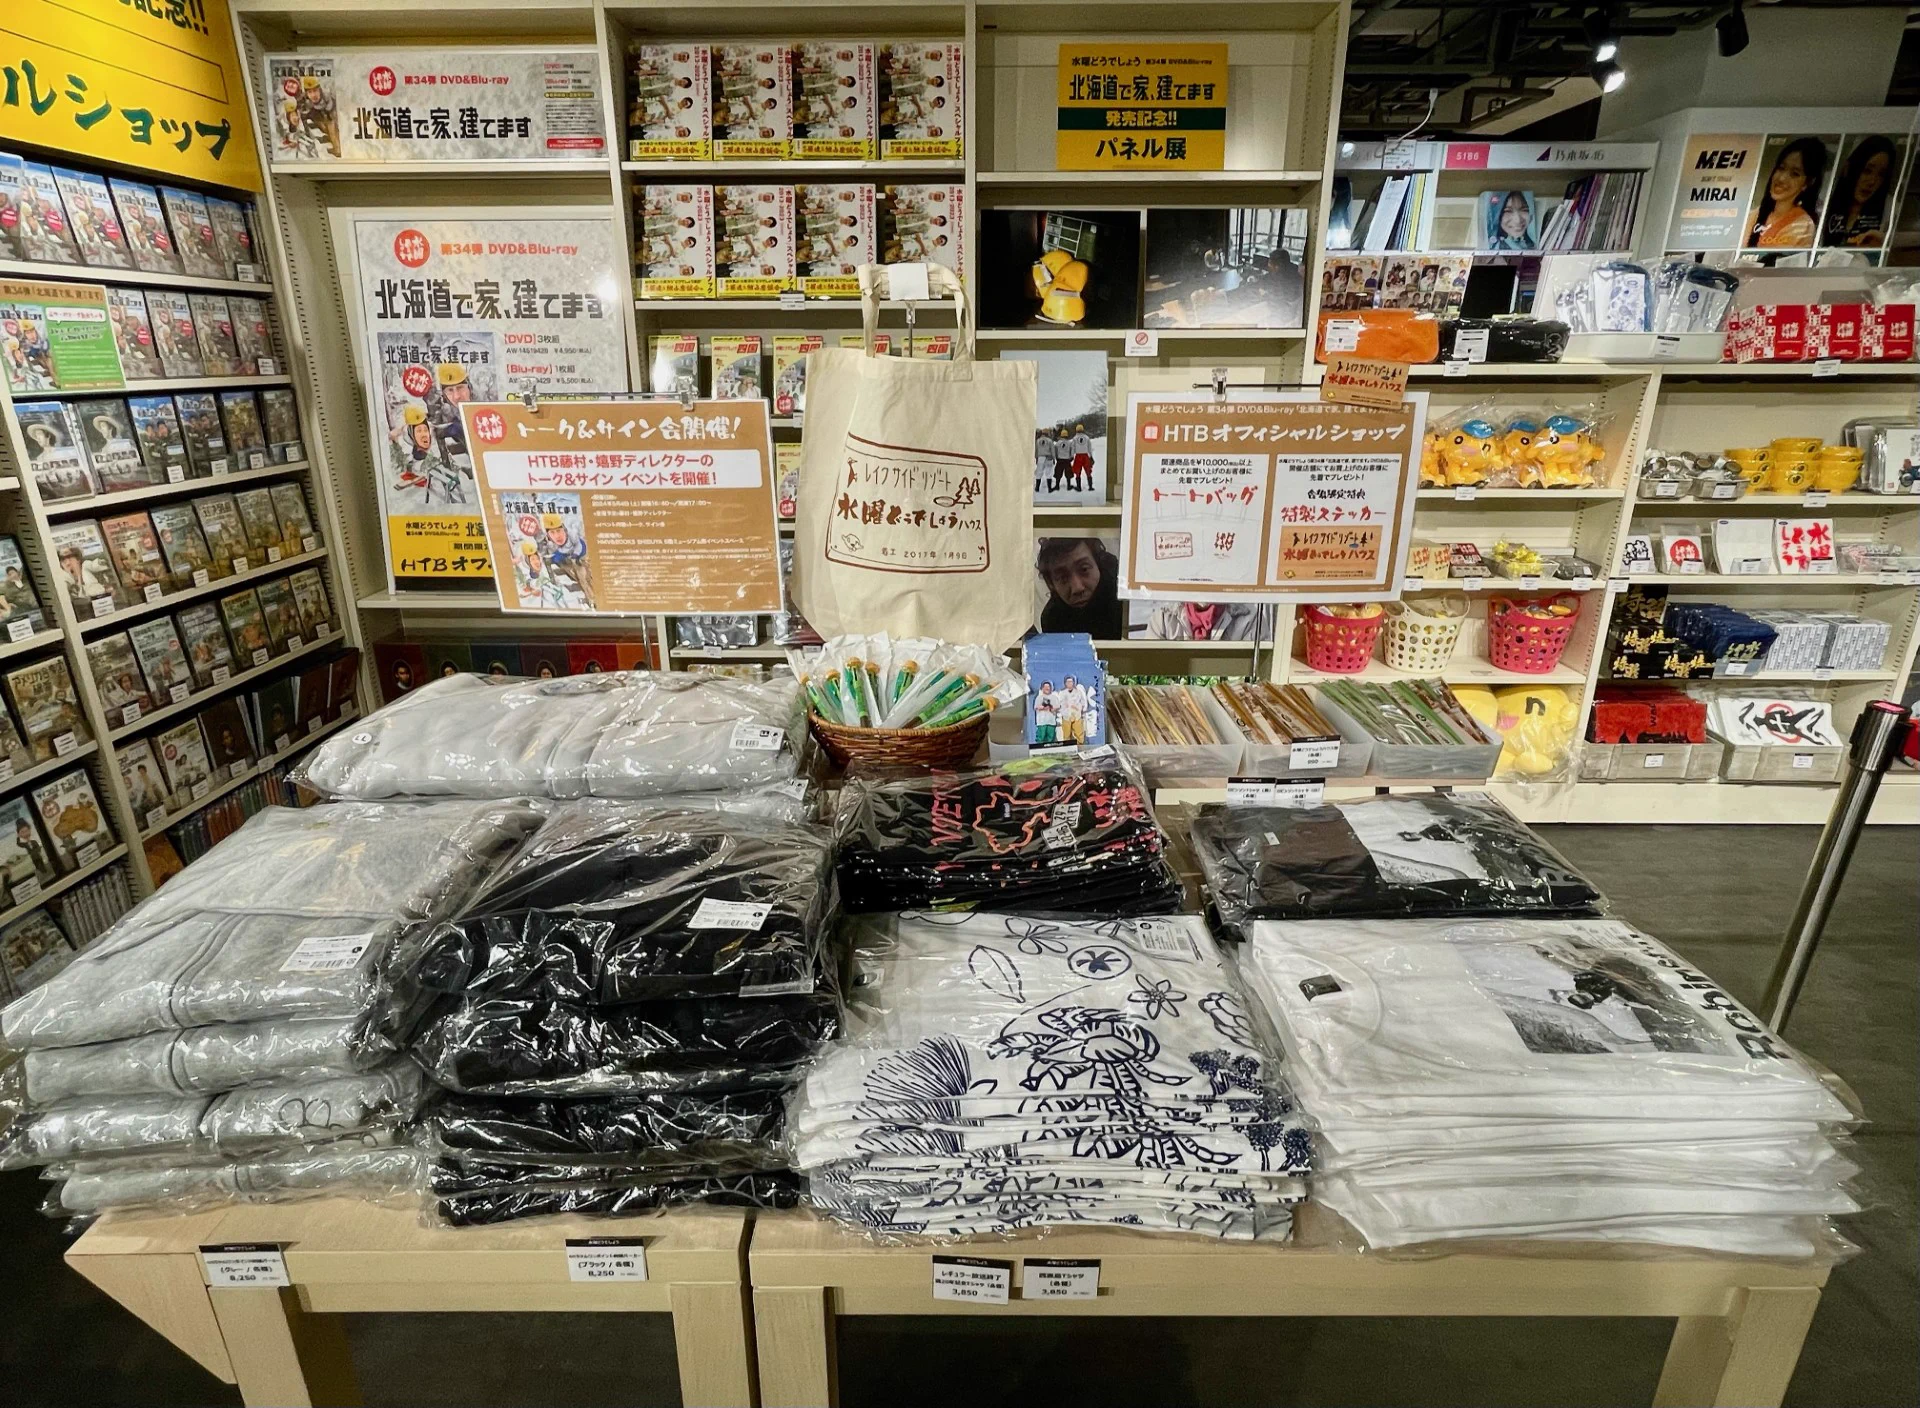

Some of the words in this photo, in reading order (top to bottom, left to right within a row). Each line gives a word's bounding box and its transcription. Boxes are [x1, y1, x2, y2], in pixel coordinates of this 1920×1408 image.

[1072, 56, 1141, 67] 水曜どうでしょう
[404, 75, 436, 86] 第34弾
[440, 75, 510, 87] DVD&Blu-ray
[1069, 74, 1215, 101] 北海道で家、建てます
[2, 59, 231, 161] ルショップ
[1105, 110, 1177, 126] 発売記念!!
[353, 106, 532, 140] 北海道で家、建てます
[1095, 137, 1187, 160] パネル展
[1690, 187, 1738, 201] MIRAI
[440, 243, 484, 257] 第34弾
[488, 243, 579, 257] DVD&Blu-ray
[375, 278, 604, 320] 北海道で家、建てます
[385, 345, 490, 365] 北海道で家、建てます
[1145, 404, 1204, 414] 水曜どうでしょう
[1237, 405, 1295, 415] DVD&Blu-ray
[1153, 486, 1259, 506] トートバッグ
[1281, 504, 1387, 523] 特製ステッカー
[405, 521, 460, 531] 水曜どうでしょう
[952, 1288, 978, 1297] 3,850
